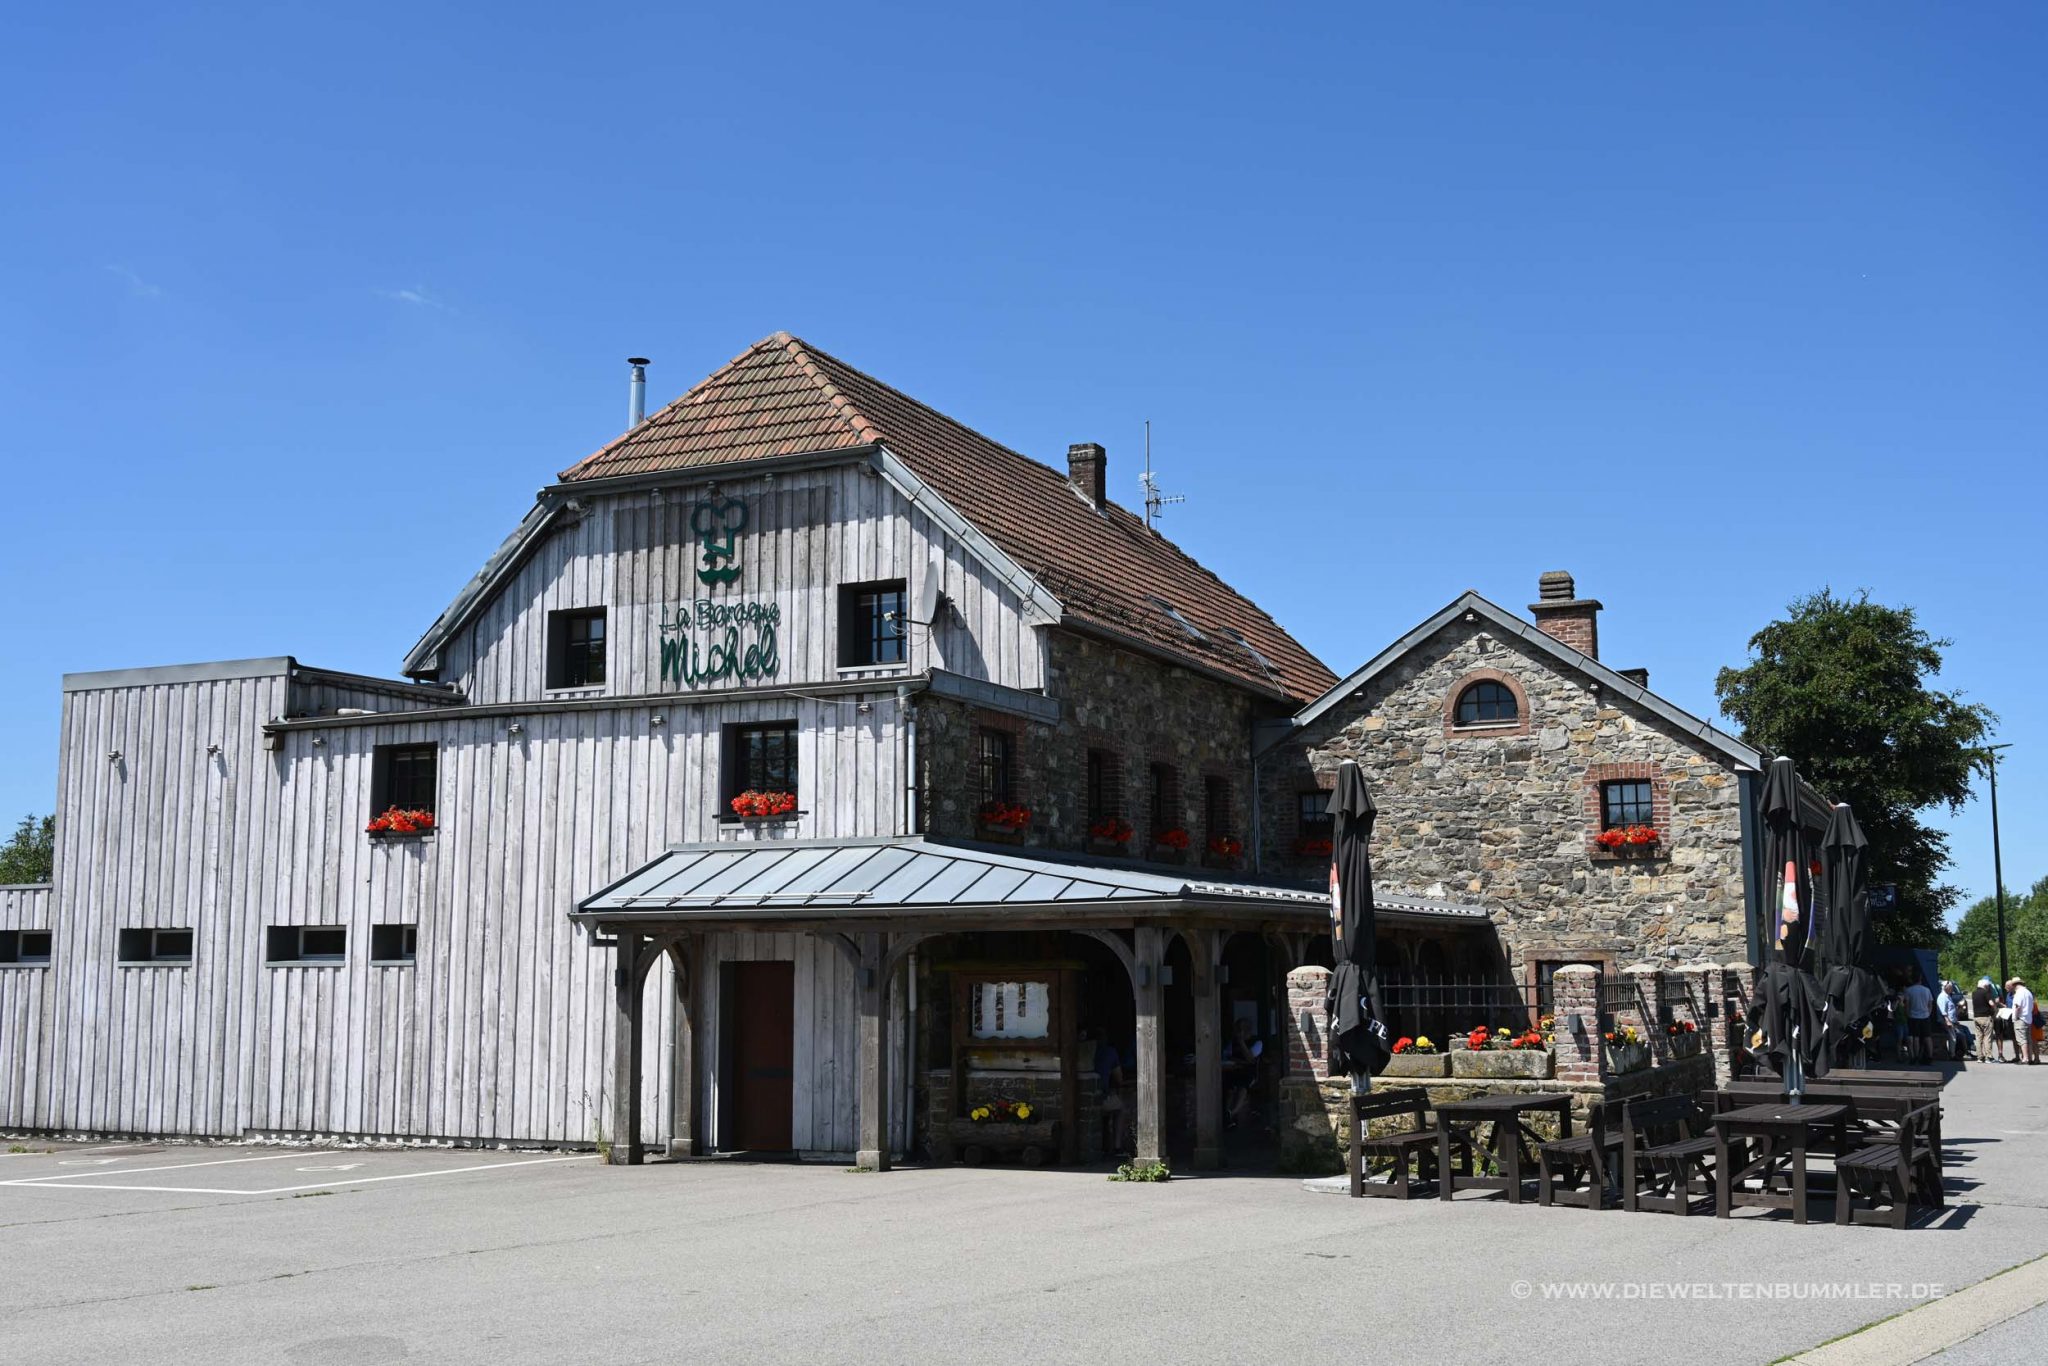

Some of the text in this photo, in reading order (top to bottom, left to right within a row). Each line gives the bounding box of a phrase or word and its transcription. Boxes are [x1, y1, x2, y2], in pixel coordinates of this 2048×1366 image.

[659, 599, 780, 631] La Baraque
[660, 624, 777, 684] Michel
